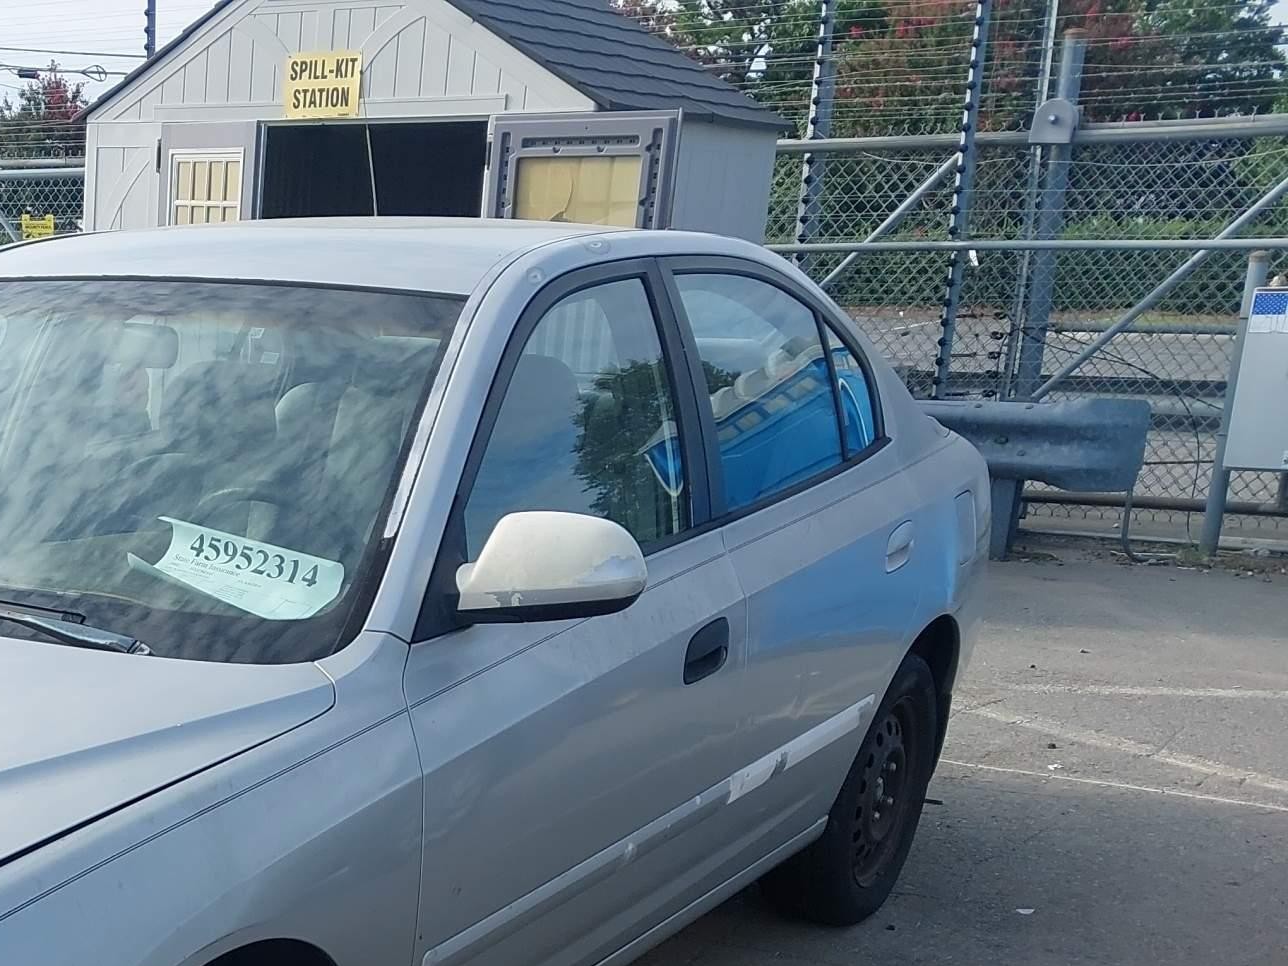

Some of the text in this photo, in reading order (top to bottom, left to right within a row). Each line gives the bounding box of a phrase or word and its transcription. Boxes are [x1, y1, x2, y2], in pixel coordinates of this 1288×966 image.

[290, 57, 358, 81] SPILL-KIT
[292, 87, 350, 109] STATION
[190, 533, 319, 588] 45952314
